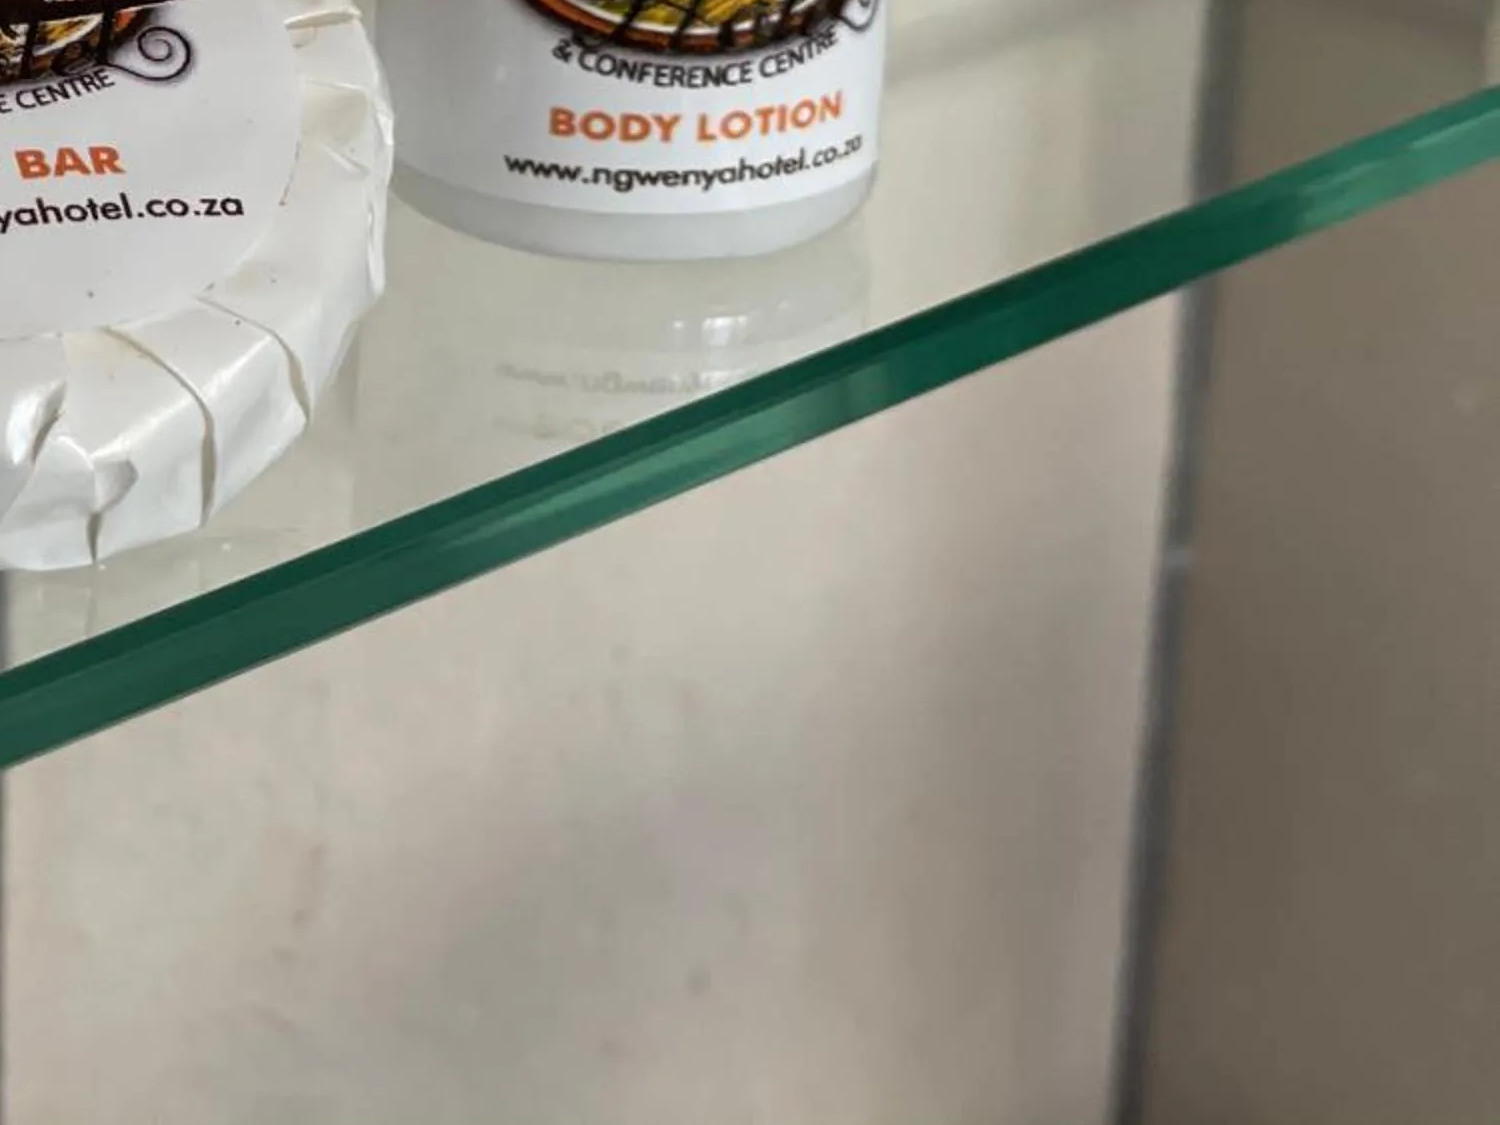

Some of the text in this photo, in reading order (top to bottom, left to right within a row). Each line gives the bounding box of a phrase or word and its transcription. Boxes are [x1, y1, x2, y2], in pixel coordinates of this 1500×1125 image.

[552, 26, 840, 88] & CONFERENCE CENTRE
[18, 70, 115, 109] CENTRE
[550, 91, 844, 142] BODY LOTION
[14, 144, 127, 180] BAR
[503, 134, 863, 192] www.ngwenyahotel.co.za
